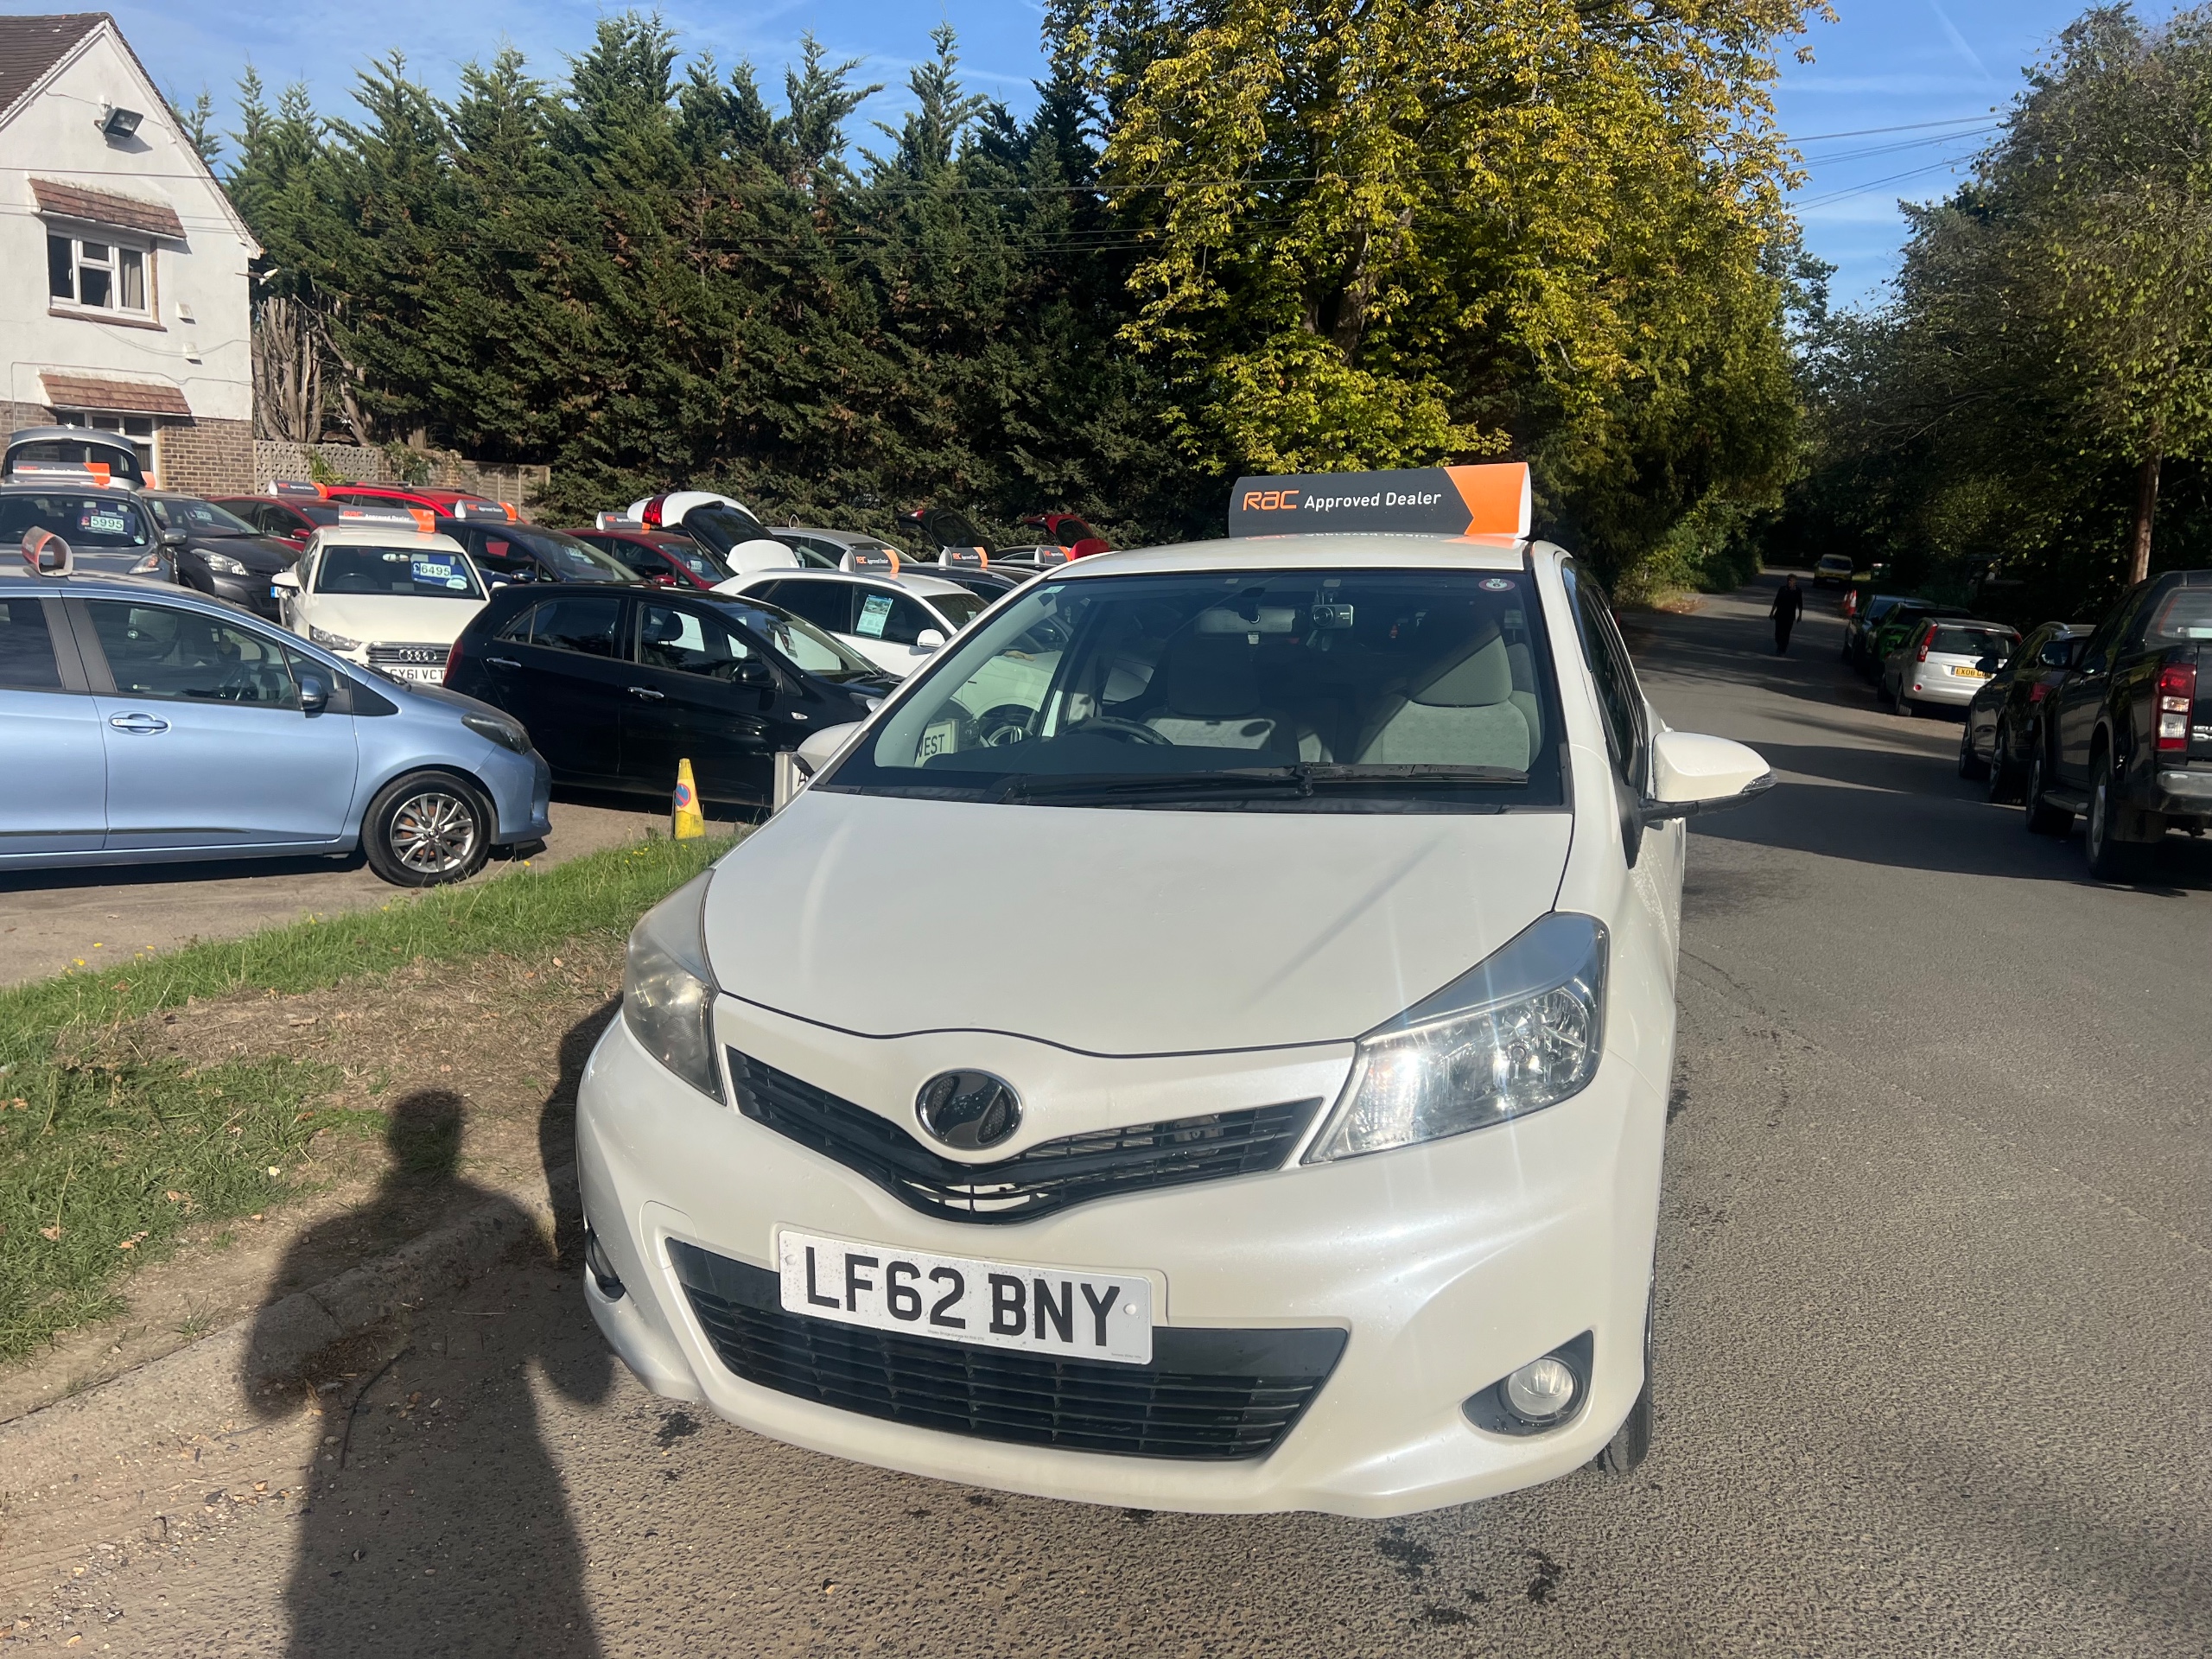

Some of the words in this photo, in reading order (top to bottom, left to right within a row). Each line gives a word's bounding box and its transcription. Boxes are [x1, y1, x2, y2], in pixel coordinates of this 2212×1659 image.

[1304, 493, 1381, 512] Approved
[1385, 492, 1442, 506] Dealer
[423, 669, 445, 680] VCT
[805, 1246, 966, 1330] LF62
[988, 1273, 1121, 1347] BNY
